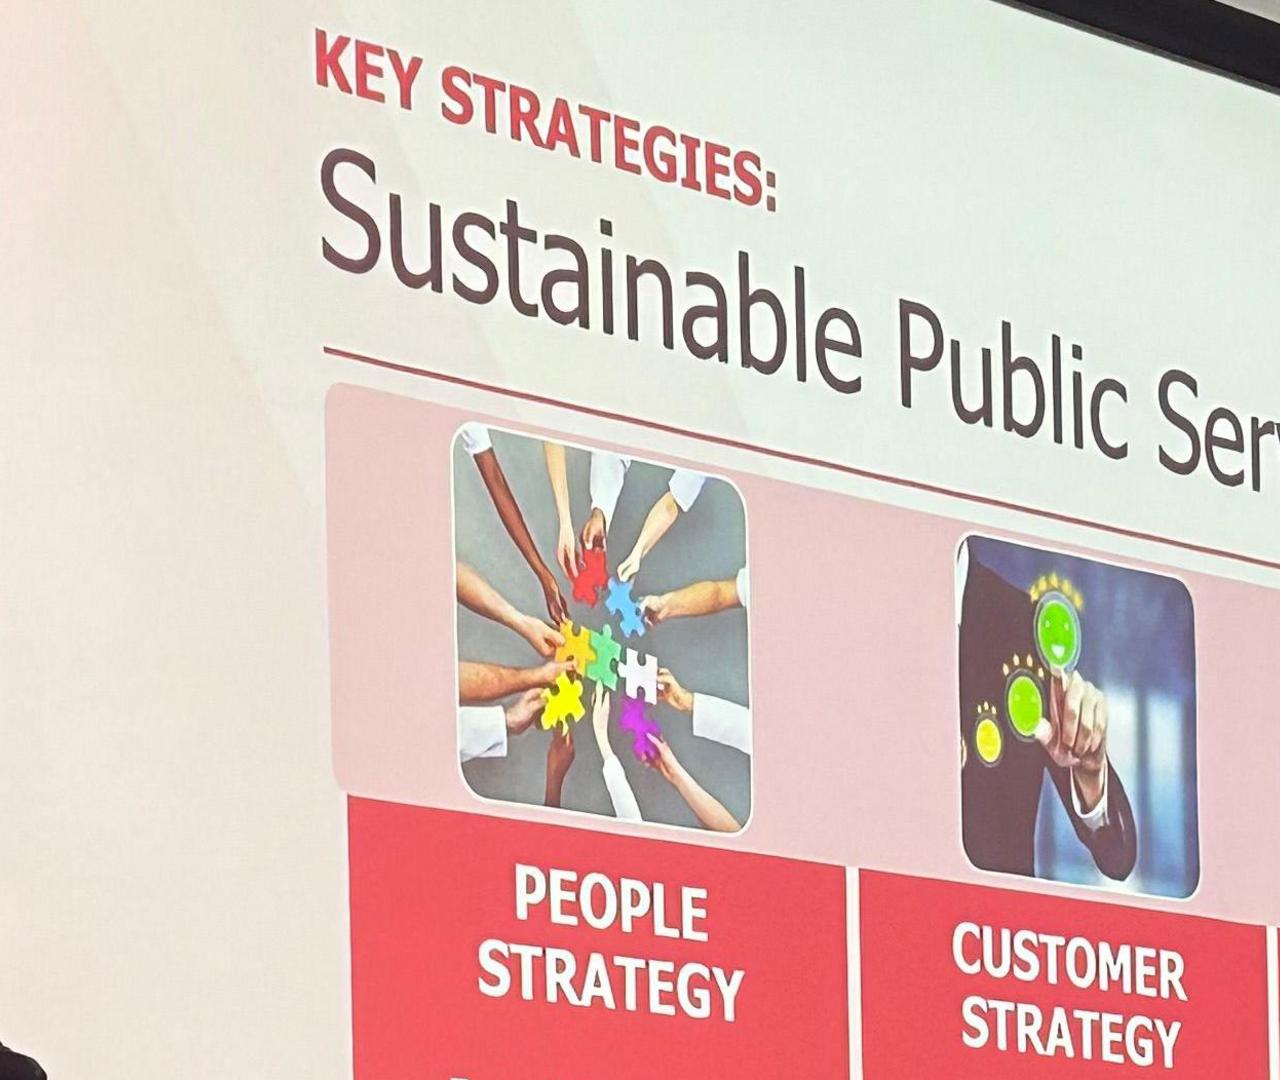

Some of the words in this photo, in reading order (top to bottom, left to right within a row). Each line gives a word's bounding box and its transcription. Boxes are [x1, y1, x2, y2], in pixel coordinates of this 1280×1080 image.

[315, 28, 423, 110] KEY
[442, 66, 776, 212] STRATEGIES:
[321, 148, 862, 394] Sustainable
[899, 298, 1128, 460] Public
[516, 864, 708, 941] PEOPLE
[479, 939, 744, 1021] STRATEGY
[953, 922, 1187, 1001] CUSTOMER
[963, 996, 1181, 1068] STRATEGY
